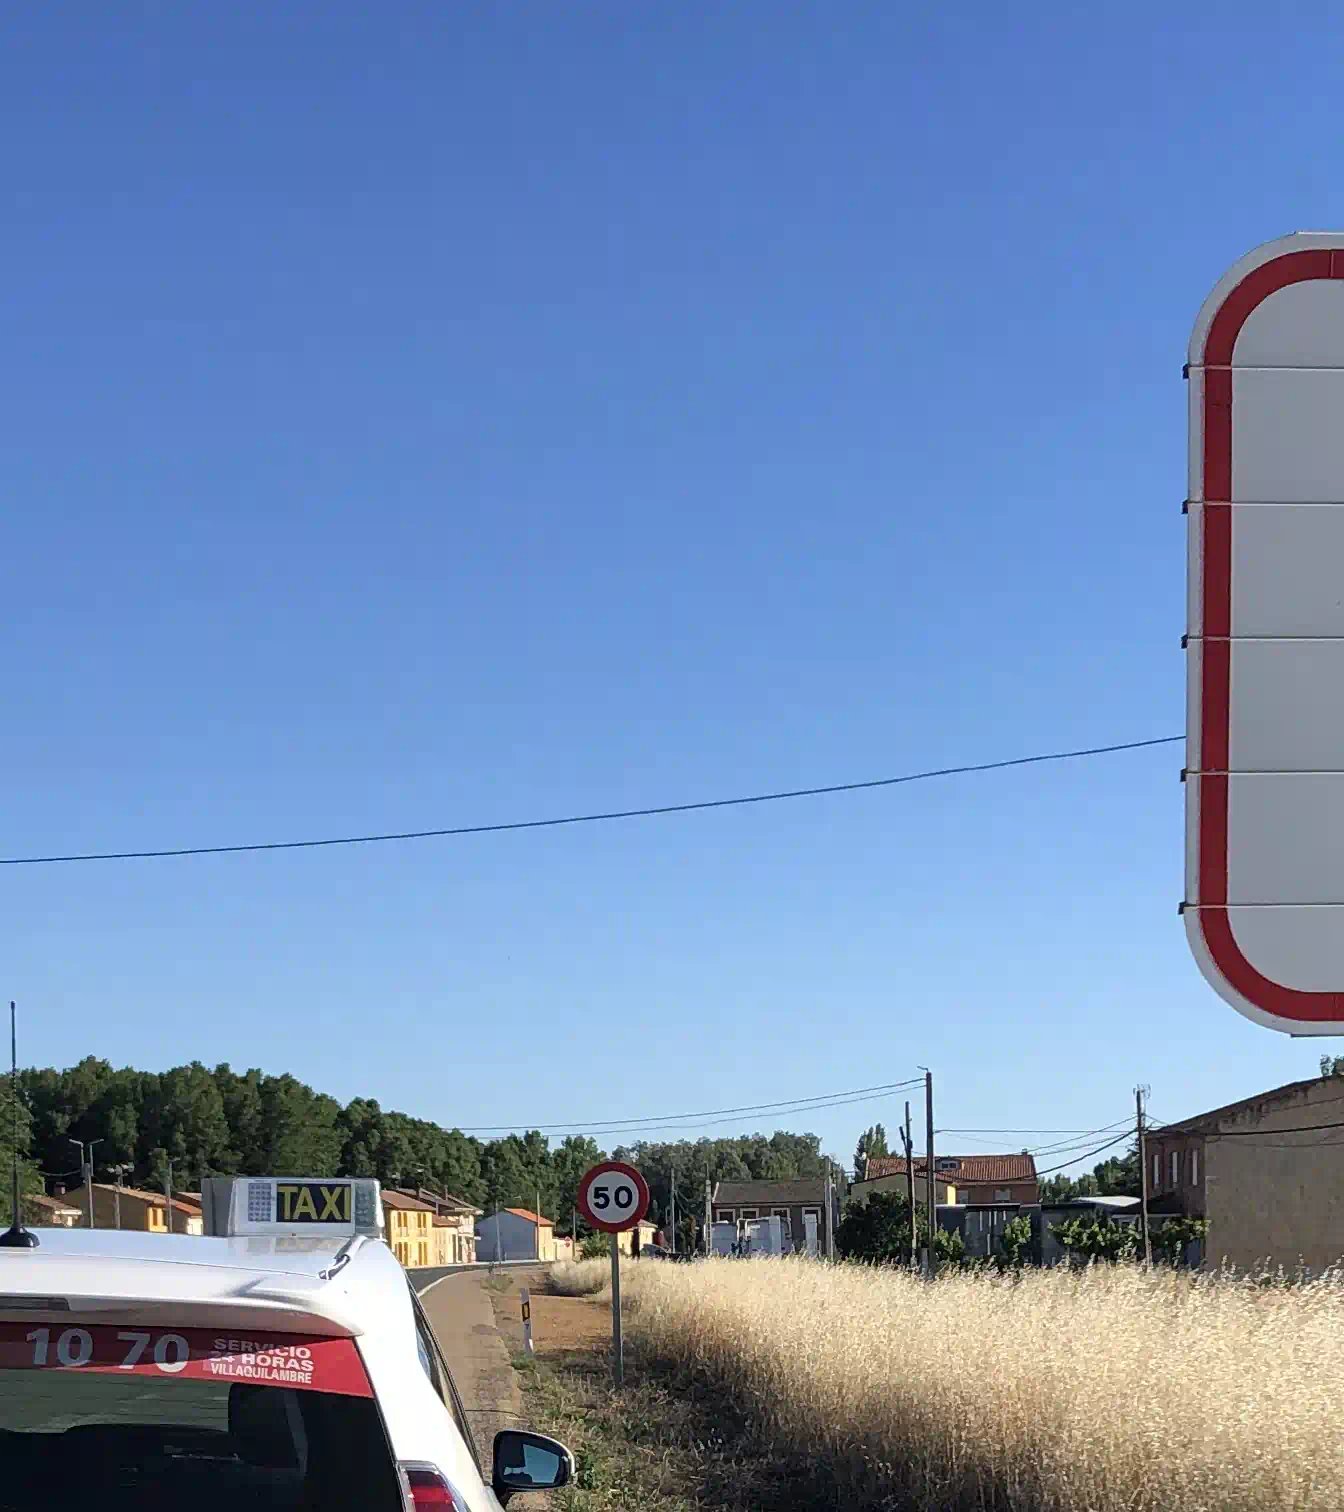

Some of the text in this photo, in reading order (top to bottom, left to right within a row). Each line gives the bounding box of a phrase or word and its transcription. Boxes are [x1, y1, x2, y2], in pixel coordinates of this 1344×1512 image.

[277, 1186, 352, 1221] TAXI
[593, 1186, 633, 1210] 50
[26, 1328, 93, 1368] 10
[117, 1331, 190, 1373] 70
[214, 1338, 311, 1359] SERVICIO
[211, 1363, 312, 1384] VILLAQUILAMBRE
[241, 1353, 314, 1372] HORAS
